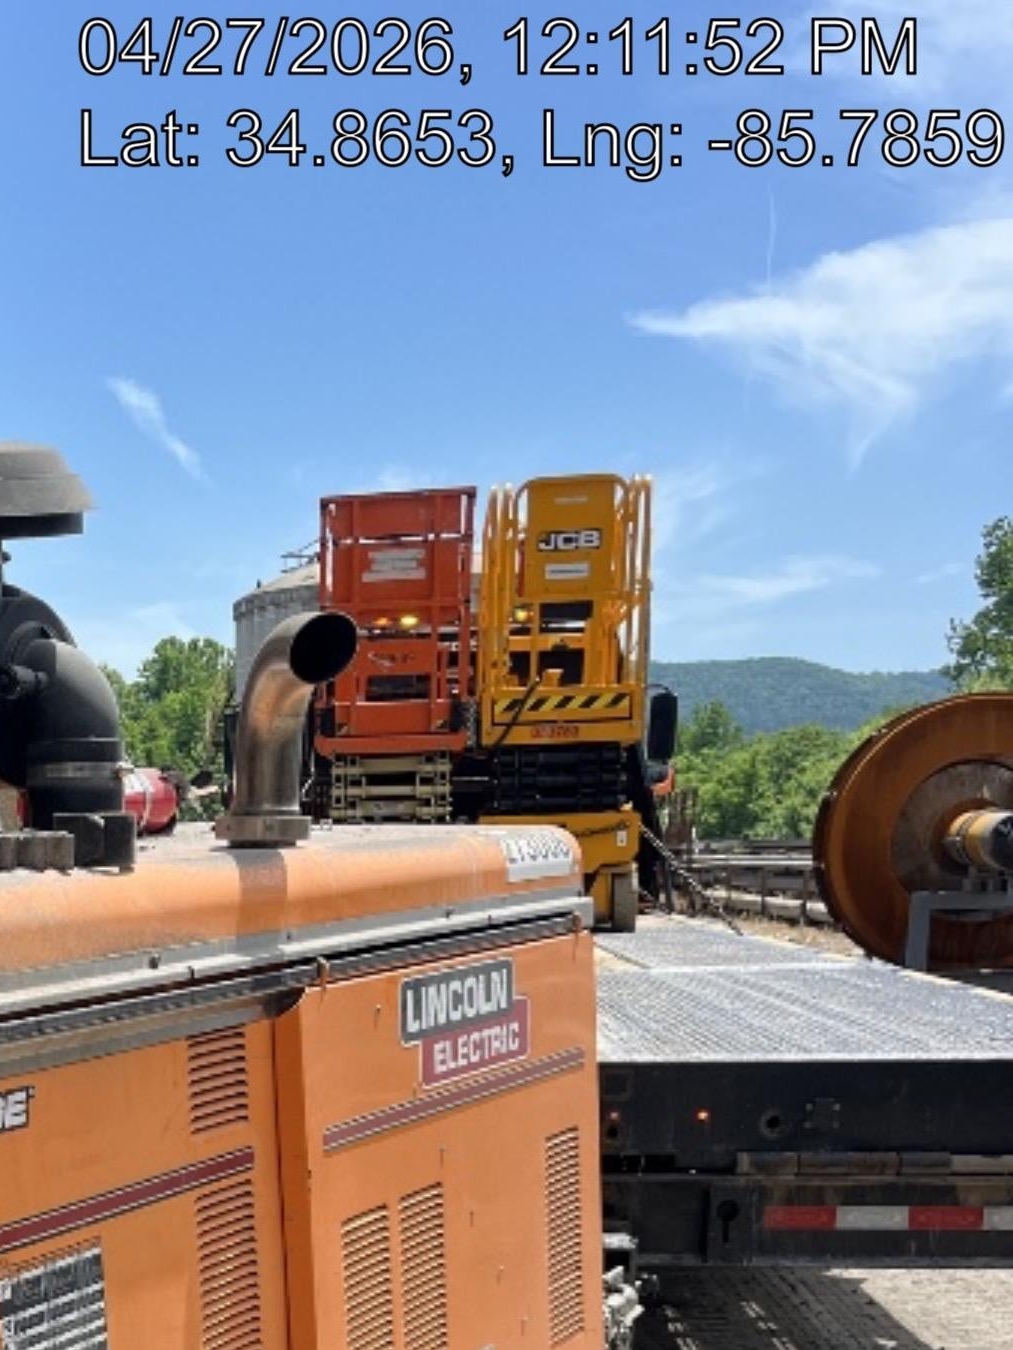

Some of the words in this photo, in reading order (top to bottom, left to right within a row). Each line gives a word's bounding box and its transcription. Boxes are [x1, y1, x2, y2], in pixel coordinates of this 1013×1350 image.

[538, 528, 600, 550] JCB
[406, 968, 508, 1033] LINCOLN
[433, 1022, 519, 1075] ELECTRIC
